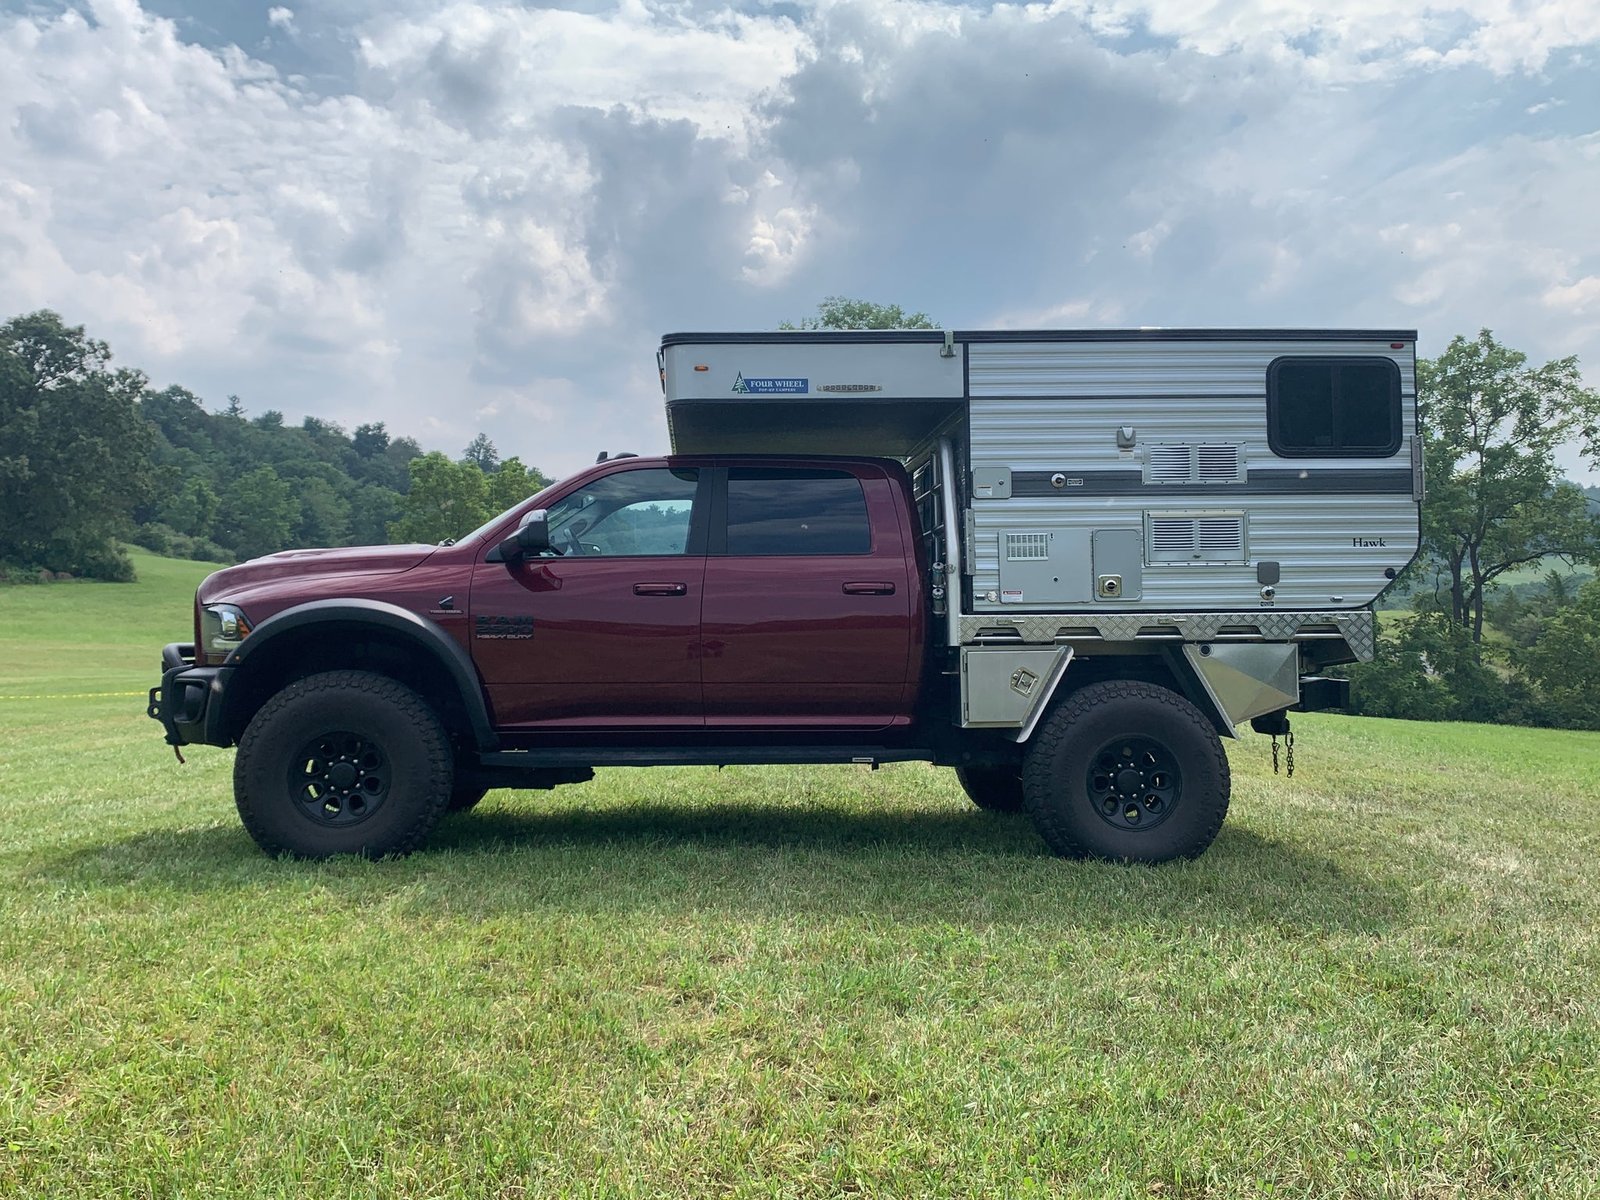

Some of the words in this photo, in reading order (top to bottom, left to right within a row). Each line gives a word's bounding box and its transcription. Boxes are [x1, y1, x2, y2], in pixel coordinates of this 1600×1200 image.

[750, 380, 773, 388] FOUR
[775, 380, 804, 388] WHEEL
[1352, 537, 1386, 547] Hawk
[475, 614, 534, 624] RAM
